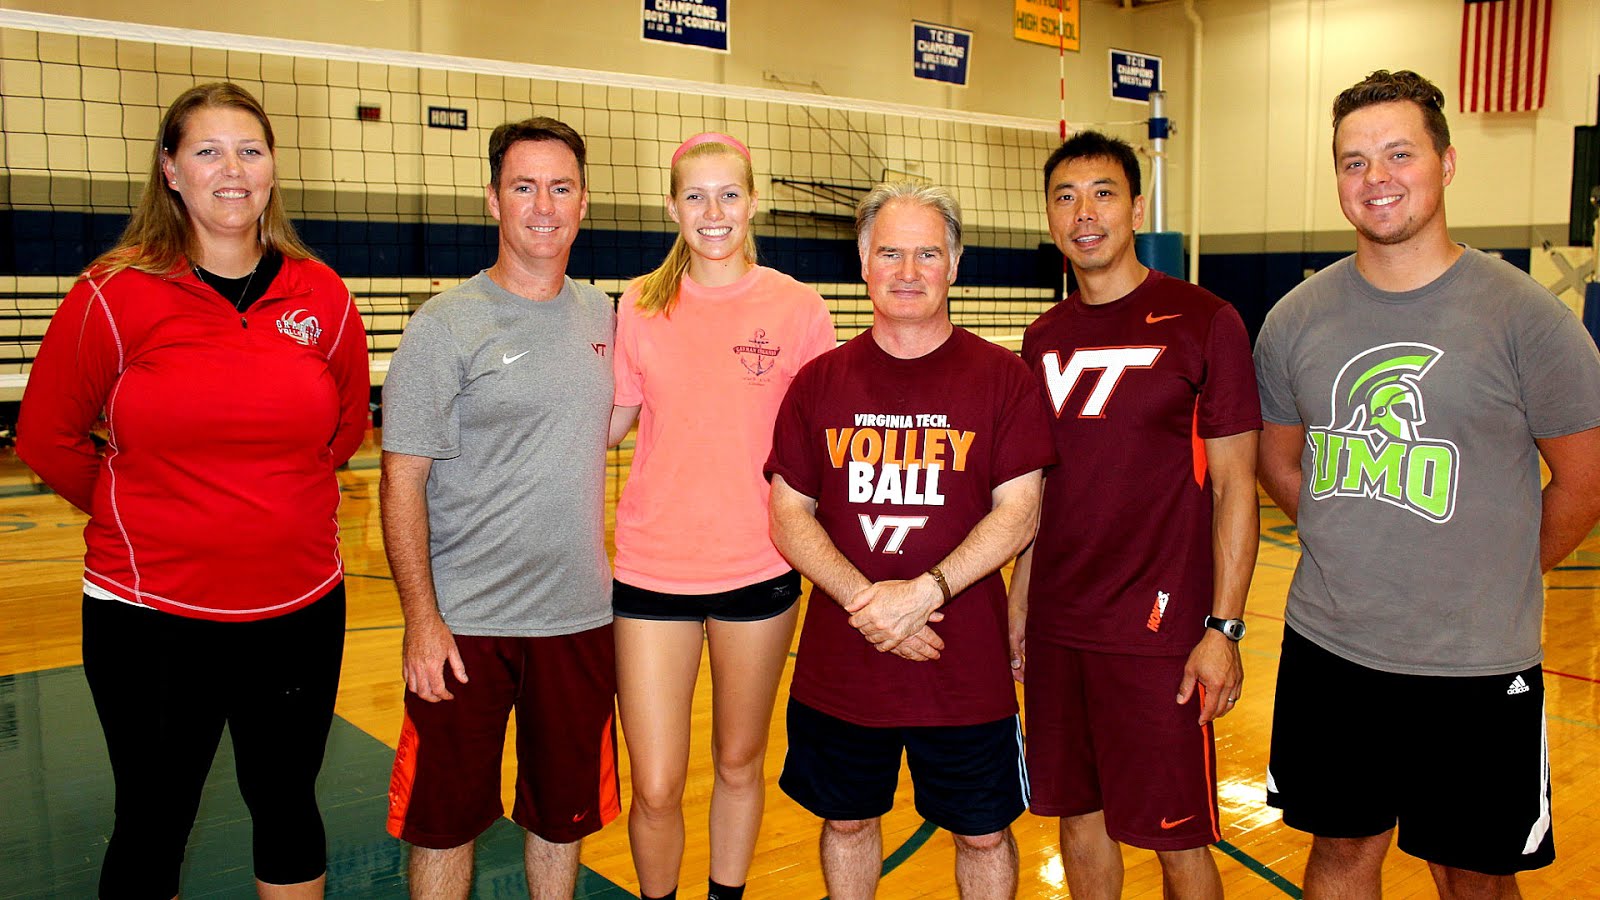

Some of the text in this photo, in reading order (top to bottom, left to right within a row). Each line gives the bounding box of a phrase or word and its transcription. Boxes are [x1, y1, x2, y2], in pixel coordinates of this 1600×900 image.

[645, 9, 670, 24] BOYS
[655, 0, 718, 20] CHAMPIONS
[1016, 10, 1039, 33] HIGH
[917, 39, 965, 59] CHAMPIONS
[1117, 64, 1154, 80] CHAMPIONS
[431, 110, 467, 128] HOME
[590, 342, 607, 357] VT
[1041, 345, 1168, 419] VT
[854, 413, 914, 429] VIRGINIA
[825, 427, 976, 472] VOLLEY
[848, 460, 945, 506] BALL
[1308, 430, 1456, 520] UMO
[1506, 685, 1530, 695] adidas
